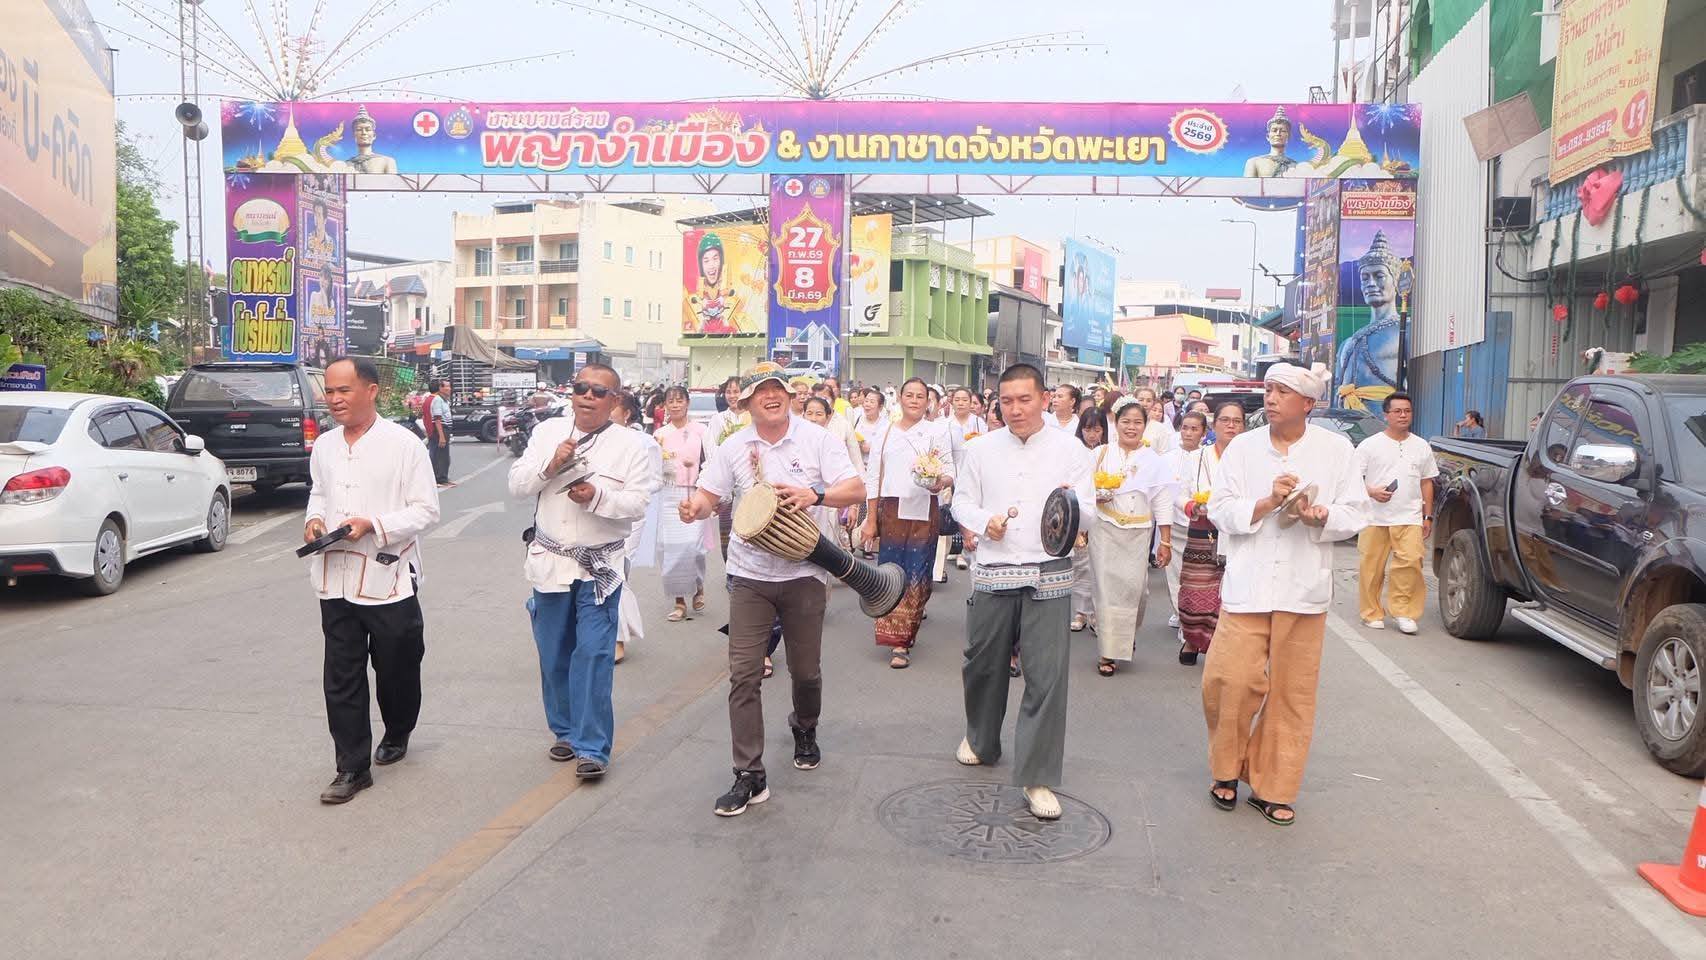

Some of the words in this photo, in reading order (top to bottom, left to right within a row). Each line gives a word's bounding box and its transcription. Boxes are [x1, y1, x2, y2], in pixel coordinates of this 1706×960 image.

[482, 118, 769, 170] พญางำเมือง
[777, 130, 801, 160] &
[808, 126, 1166, 162] งานกาชาดจังหวัดพะเยา
[1183, 127, 1212, 142] 2569
[789, 226, 823, 248] 27
[788, 250, 823, 259] ก.พ.69
[794, 267, 815, 288] 8
[788, 289, 822, 300] มี.ค.69
[232, 298, 294, 354] โปรโมชั่น
